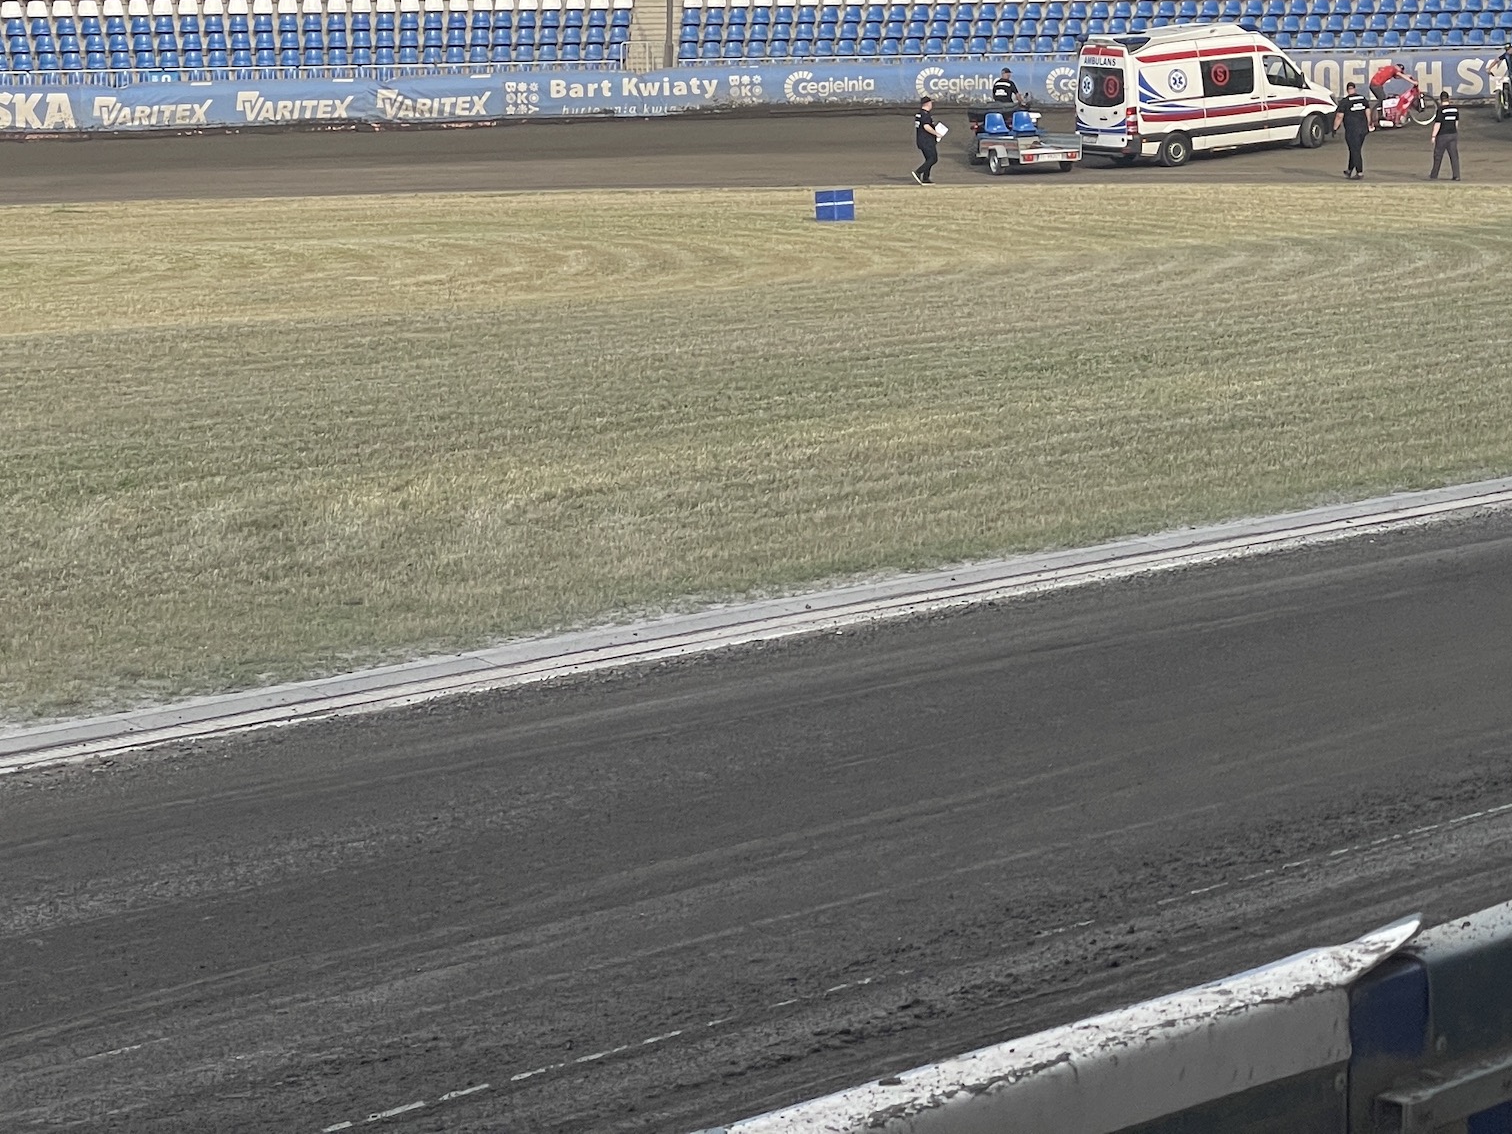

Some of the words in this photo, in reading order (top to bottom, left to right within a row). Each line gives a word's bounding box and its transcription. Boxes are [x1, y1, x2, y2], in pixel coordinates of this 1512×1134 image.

[1083, 55, 1117, 67] AMBULANS
[550, 79, 612, 99] Bart
[622, 76, 719, 99] Kwiaty
[799, 75, 875, 97] cegielnia
[930, 74, 999, 94] cegielni
[99, 98, 214, 127] VARITEX
[243, 95, 355, 121] VARITEX
[382, 91, 492, 119] VARITEX
